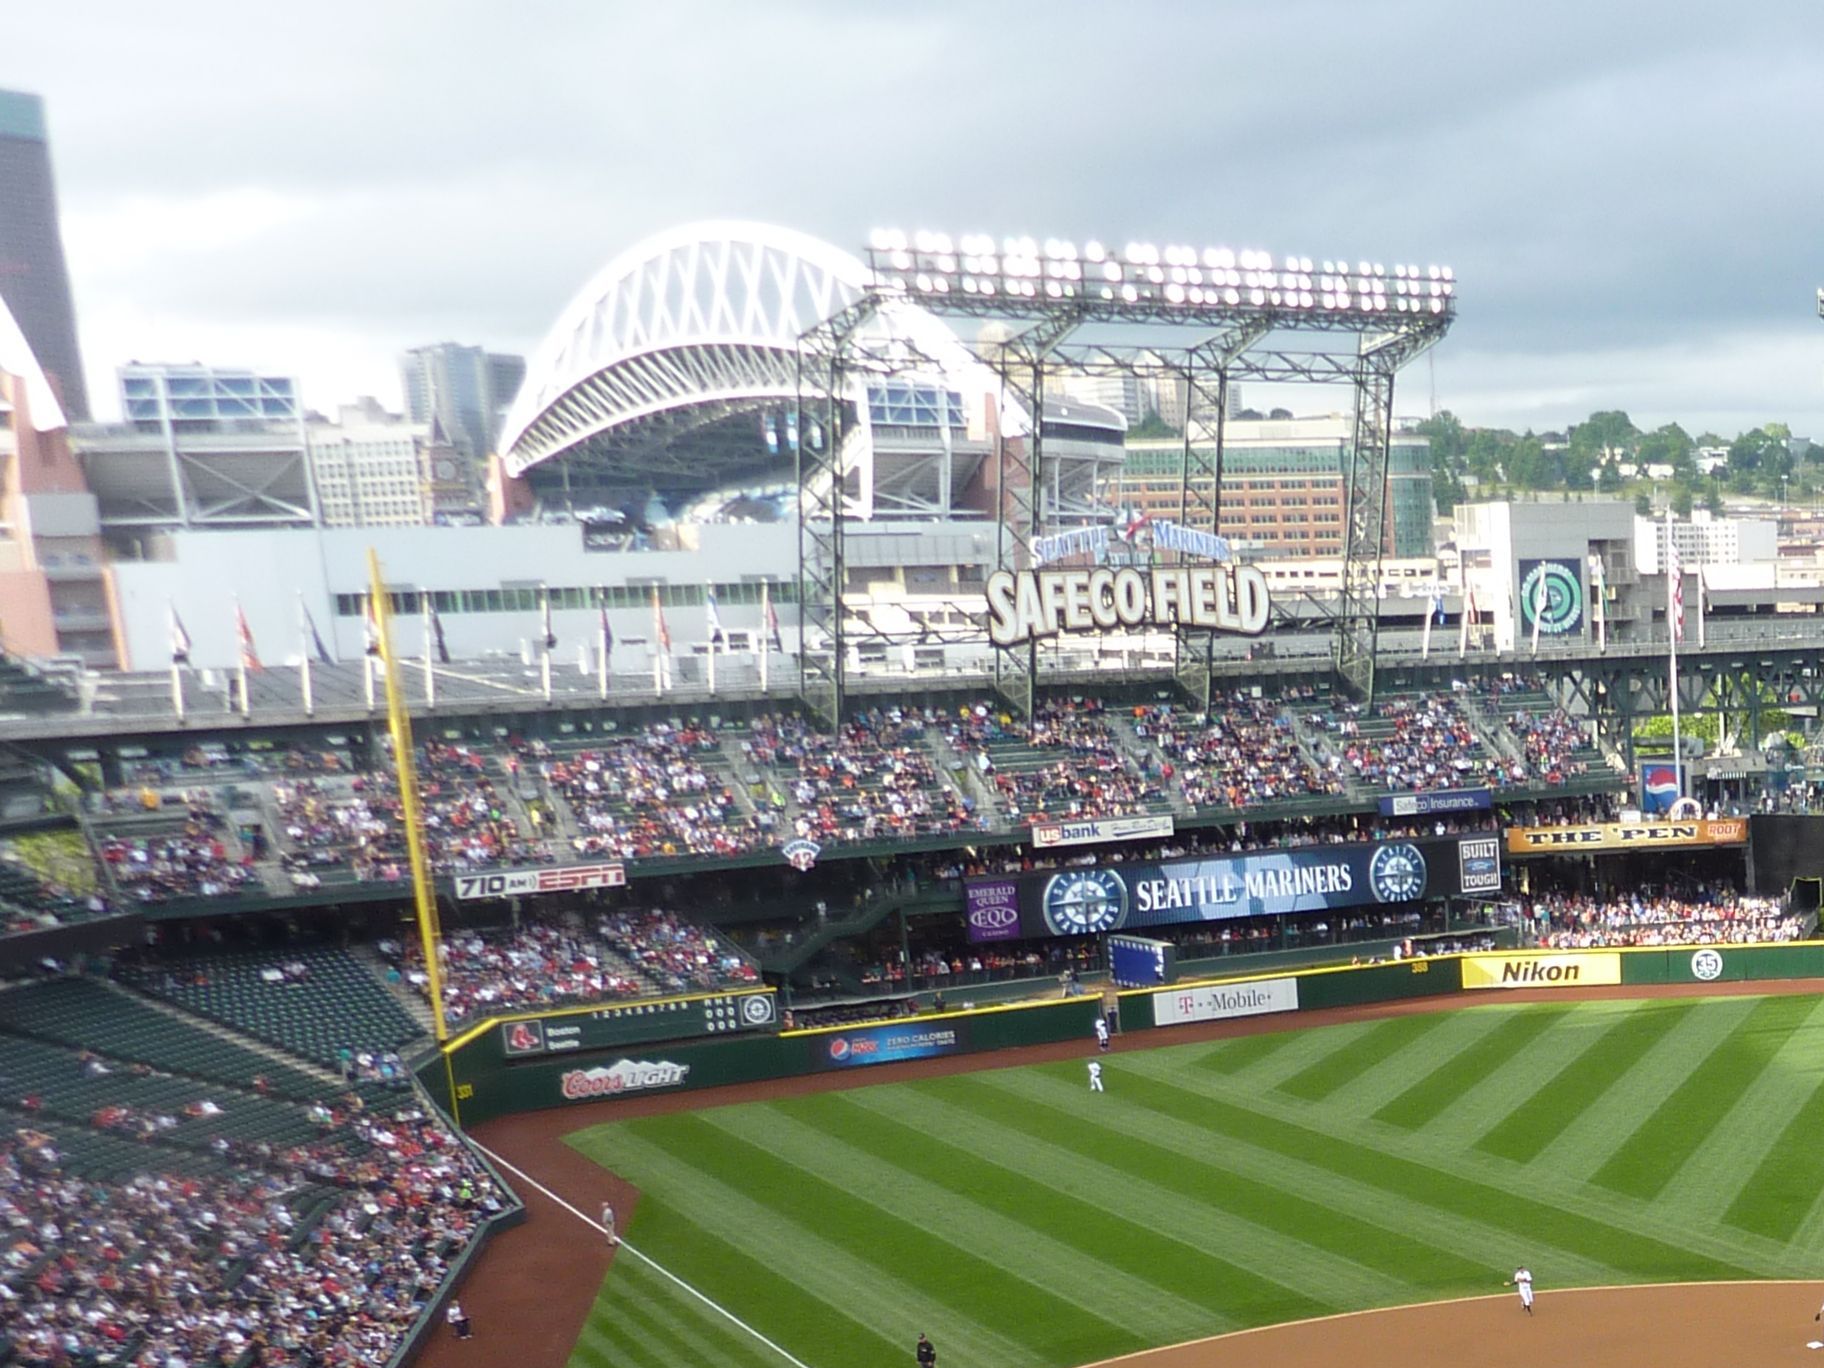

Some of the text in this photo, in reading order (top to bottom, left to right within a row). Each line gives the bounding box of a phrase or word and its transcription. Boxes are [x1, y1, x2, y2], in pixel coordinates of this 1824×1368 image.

[1152, 519, 1231, 562] MARINERS
[988, 565, 1271, 646] SAFECO FIELD
[1462, 843, 1496, 860] BUILT
[1525, 830, 1603, 846] THE
[460, 875, 505, 897] 710
[539, 866, 624, 890] ESPN
[1137, 863, 1352, 912] SEATTLE MARINERS
[1464, 872, 1498, 887] TOUGH
[1501, 960, 1580, 984] Nikon
[562, 1065, 689, 1099] Coors LIGHT
